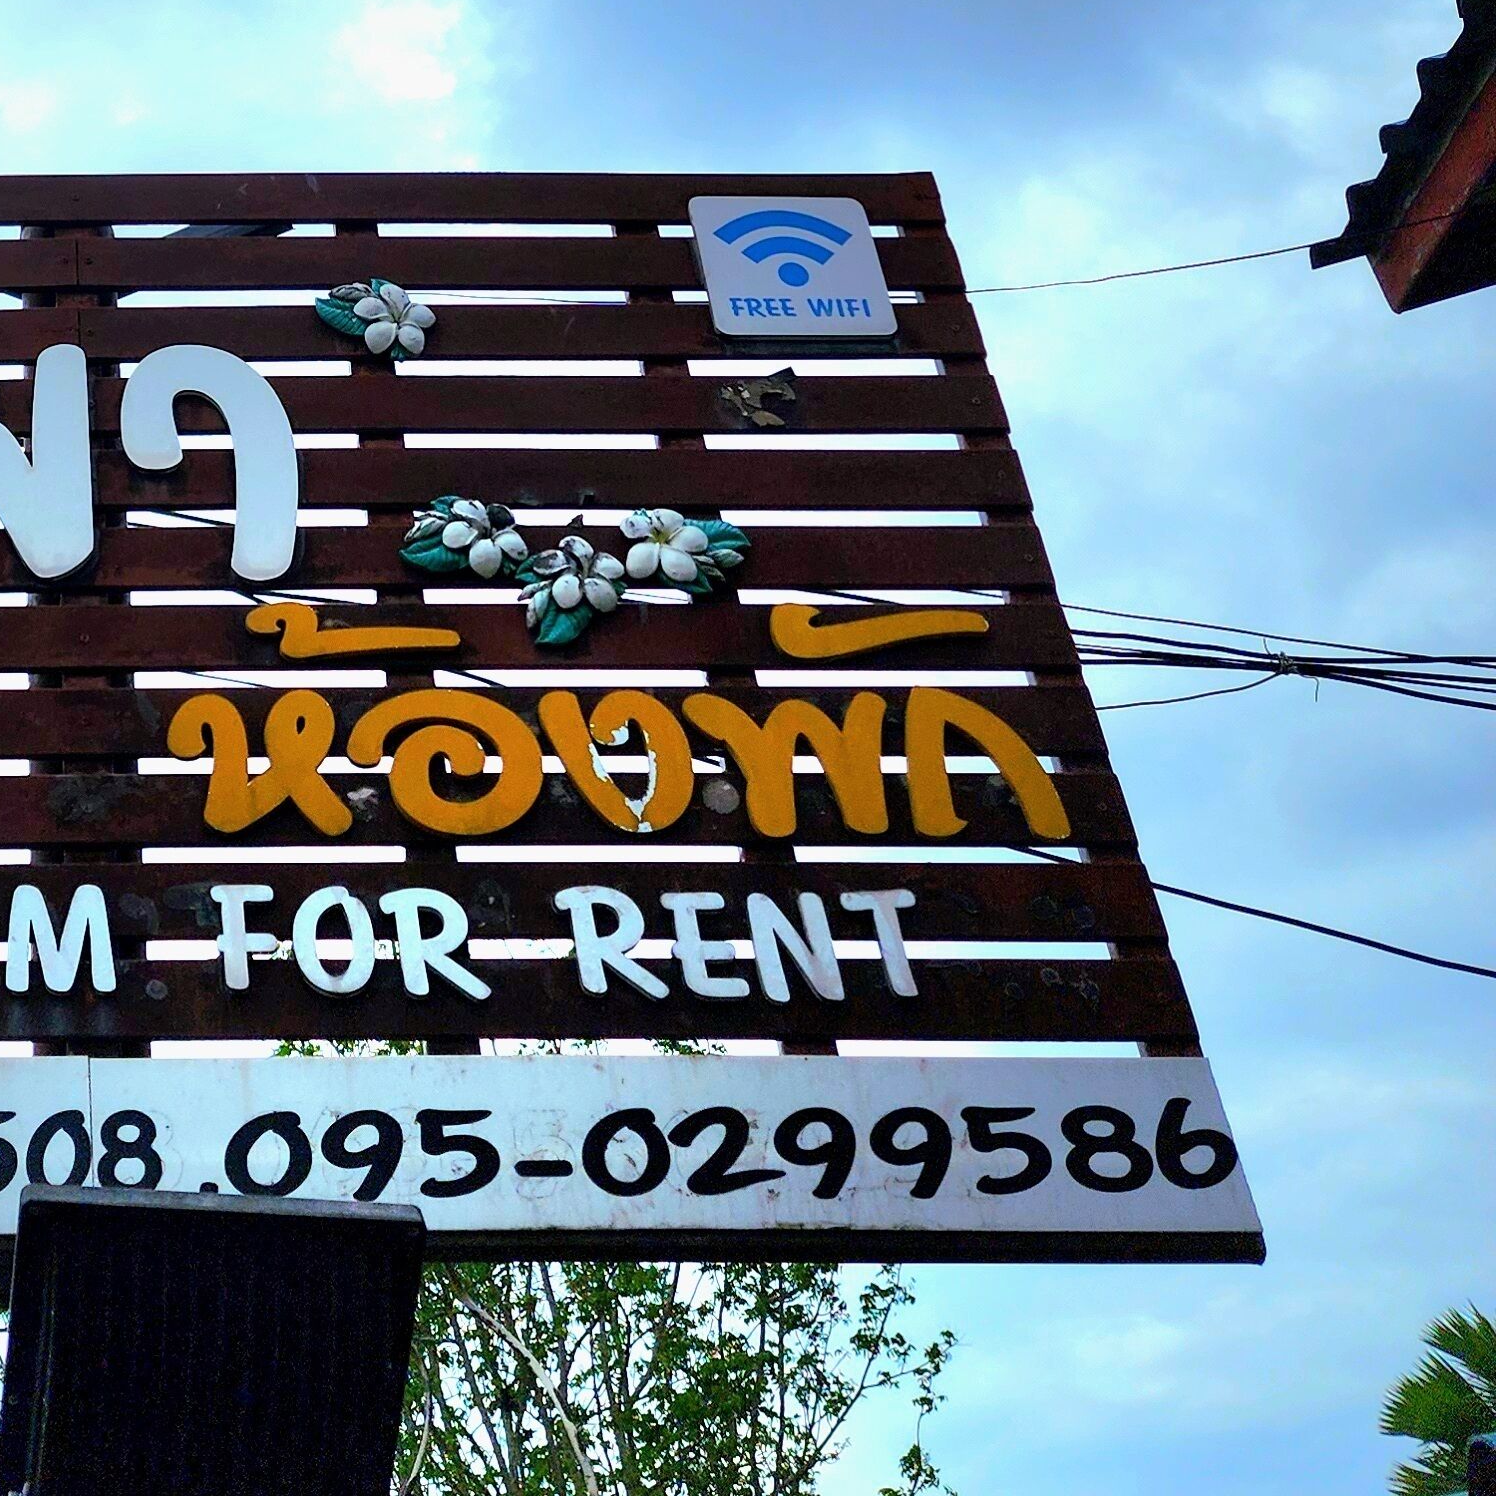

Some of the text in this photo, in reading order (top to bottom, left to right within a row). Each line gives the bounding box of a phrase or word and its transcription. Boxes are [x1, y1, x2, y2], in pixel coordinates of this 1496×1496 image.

[729, 297, 872, 318] FREE WIFI
[166, 602, 1071, 839] ห้องพัก
[210, 884, 492, 1001] FOR
[554, 885, 919, 1002] RENT
